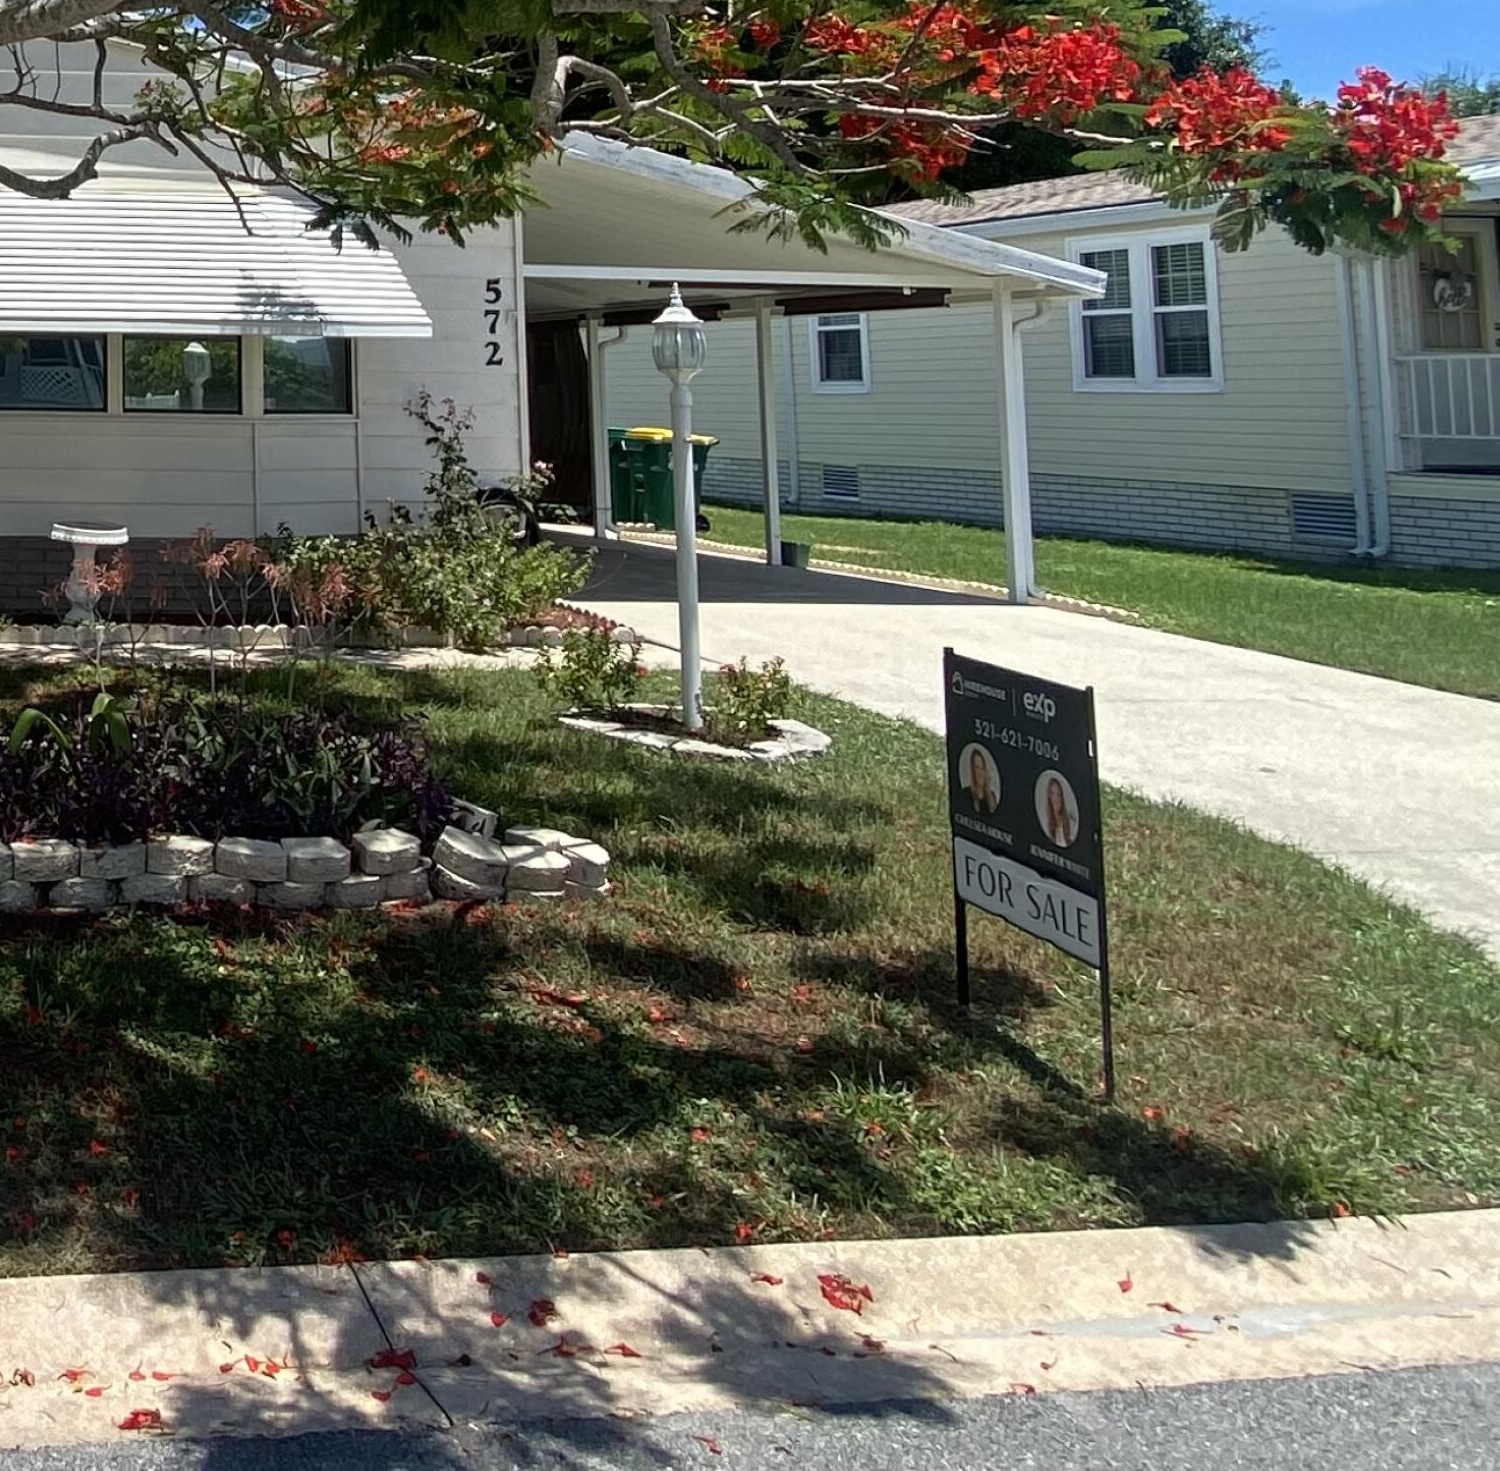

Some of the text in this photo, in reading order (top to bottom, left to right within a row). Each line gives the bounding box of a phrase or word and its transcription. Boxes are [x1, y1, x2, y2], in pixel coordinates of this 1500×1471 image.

[484, 278, 504, 367] 572
[974, 718, 1060, 761] 321-621-7006
[965, 855, 1093, 947] FOR SALE
